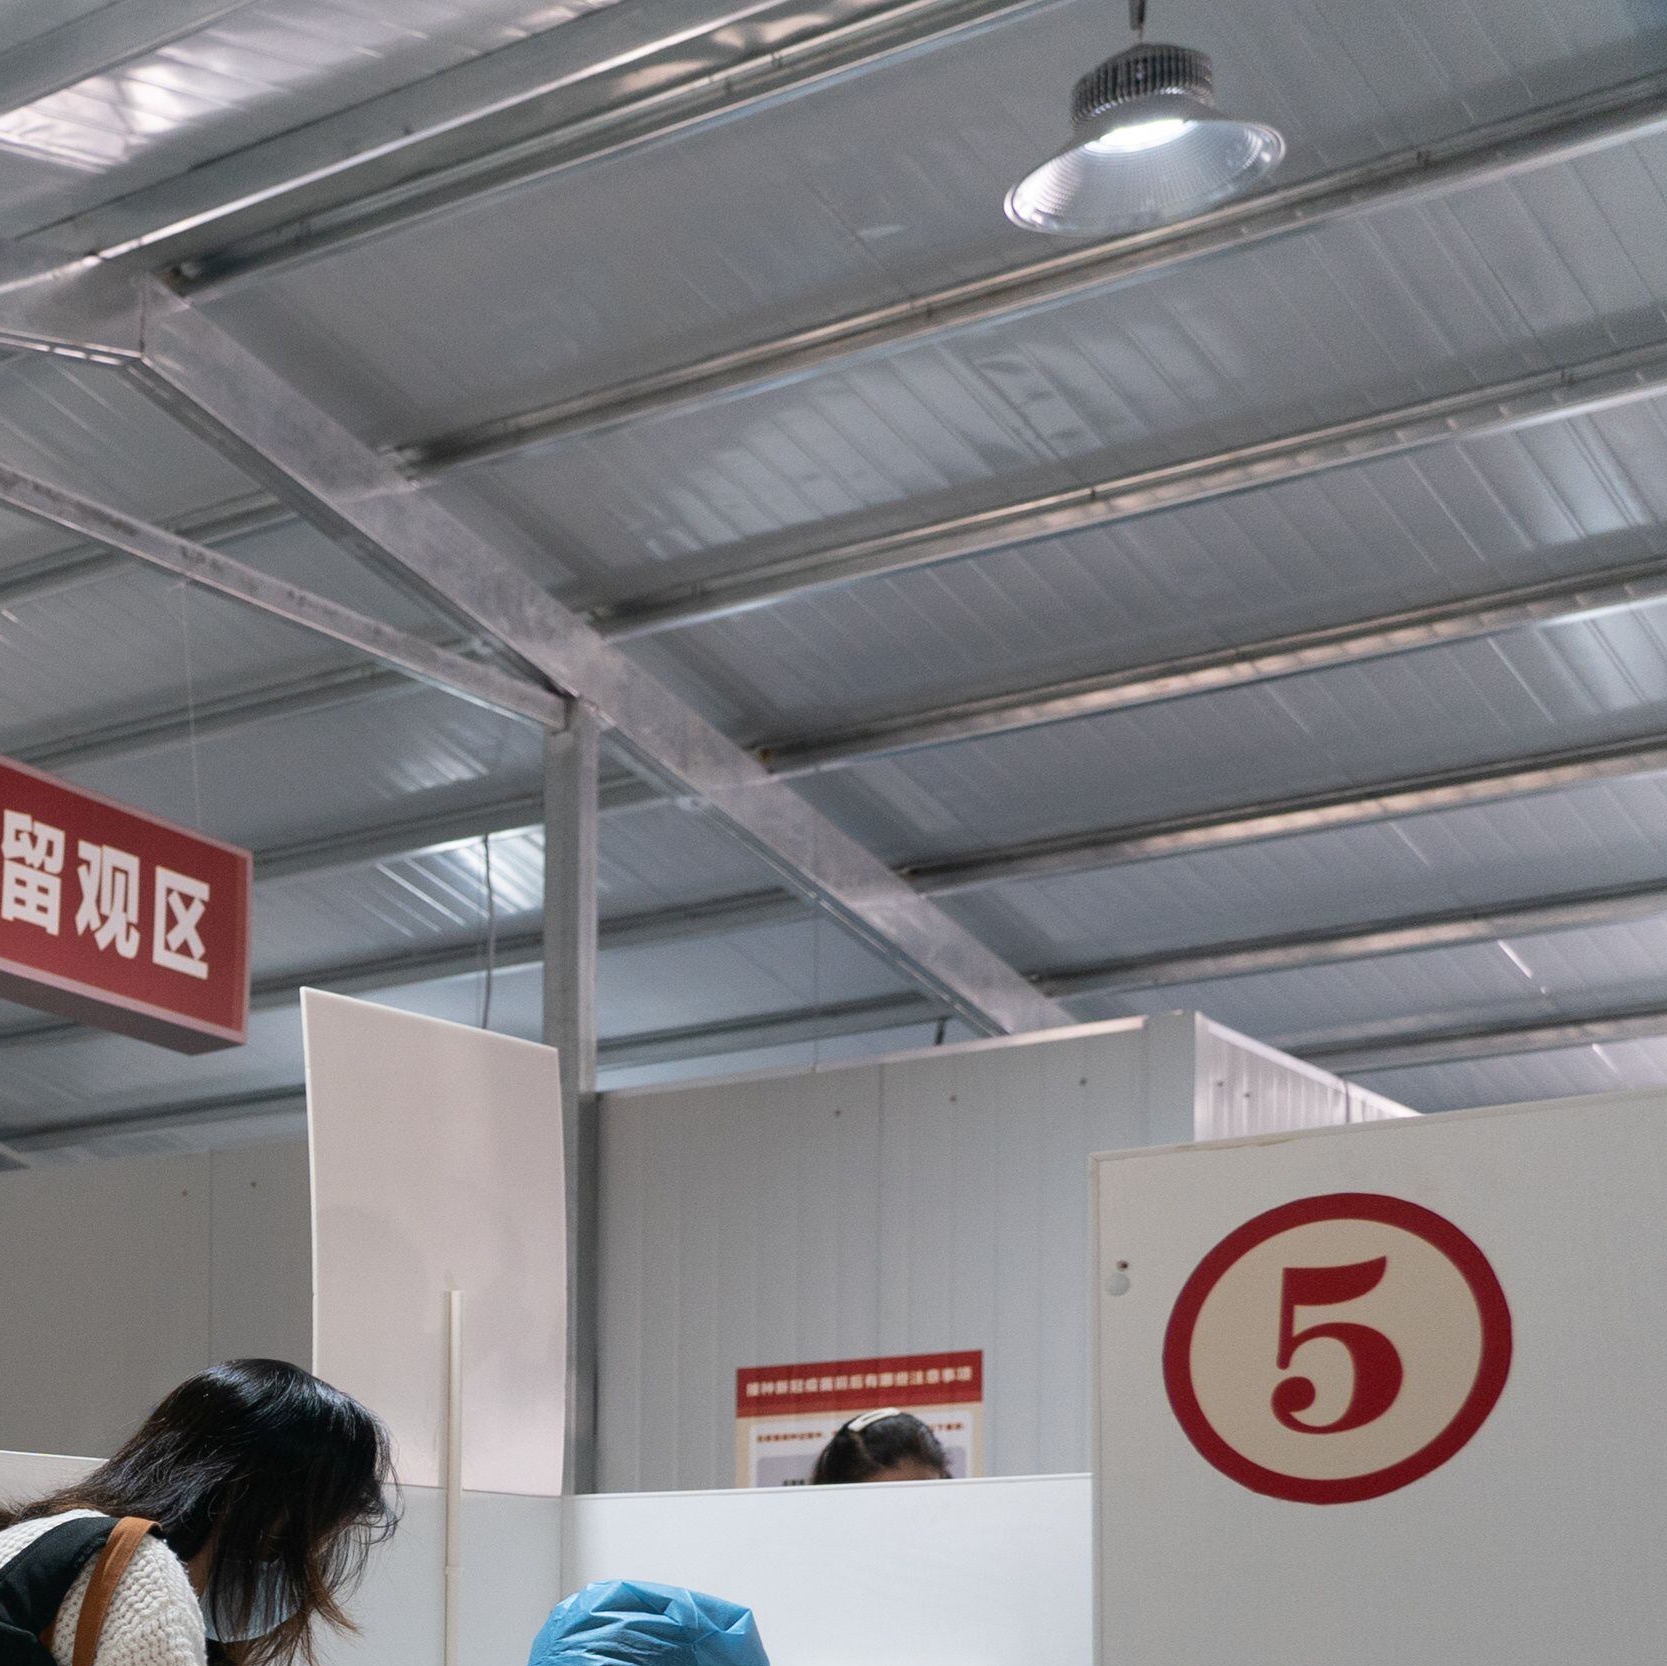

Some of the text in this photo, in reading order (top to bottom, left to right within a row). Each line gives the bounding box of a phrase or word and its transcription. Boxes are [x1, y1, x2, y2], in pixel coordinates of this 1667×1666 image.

[1, 809, 211, 980] 留观区
[1270, 1255, 1404, 1435] 5
